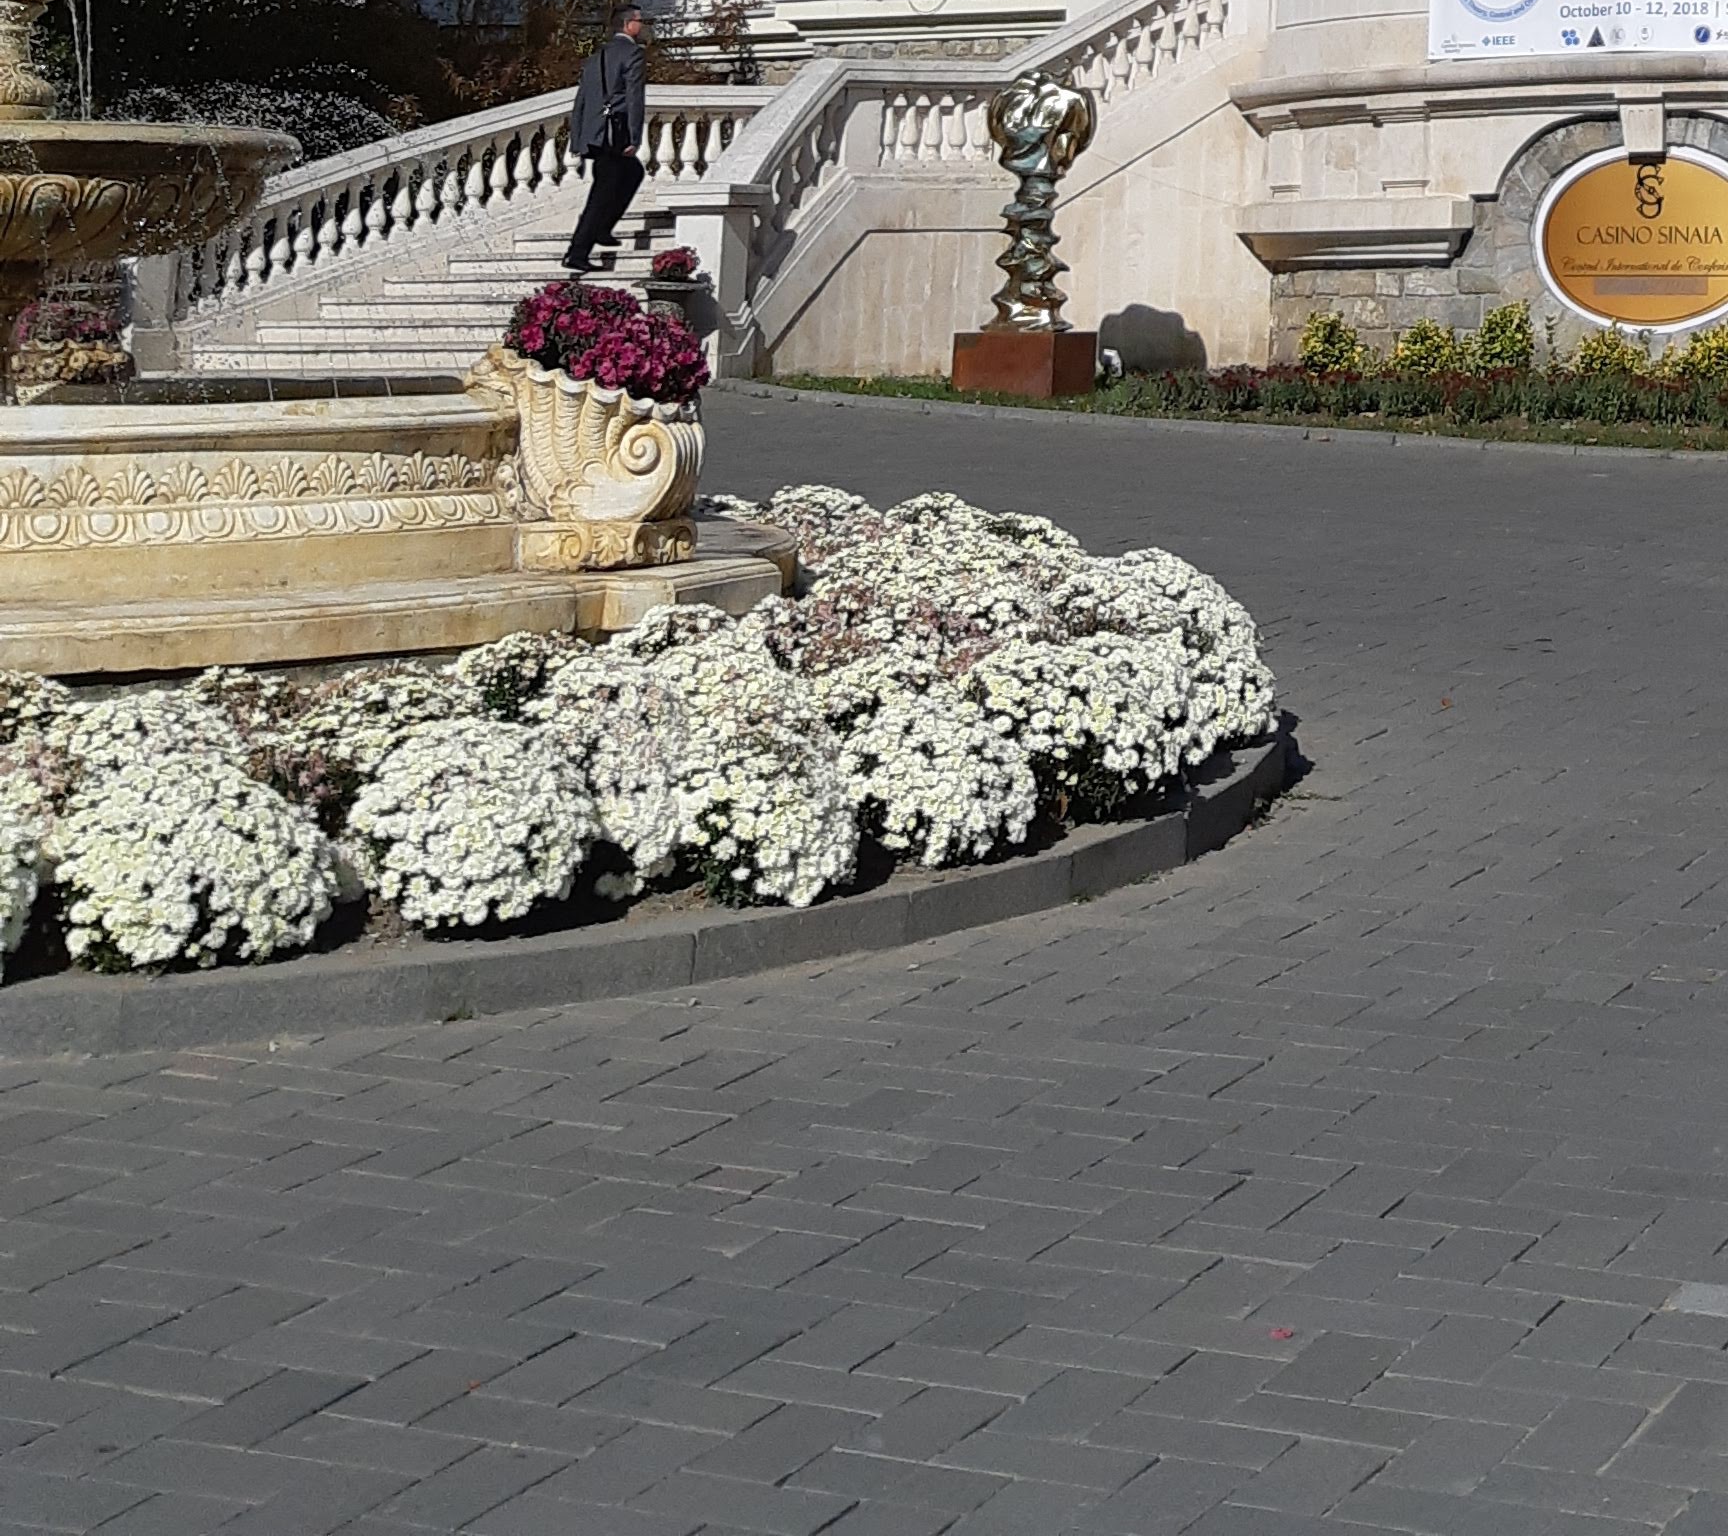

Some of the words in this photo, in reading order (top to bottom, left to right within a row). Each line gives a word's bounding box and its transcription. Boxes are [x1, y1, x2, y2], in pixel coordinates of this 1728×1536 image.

[1559, 2, 1613, 19] October
[1615, 1, 1632, 16] 10
[1646, 2, 1668, 18] 12,
[1672, 1, 1709, 16] 2018
[1491, 35, 1516, 46] IEEE
[1576, 225, 1654, 245] CASINO
[1657, 226, 1724, 245] SINAIA
